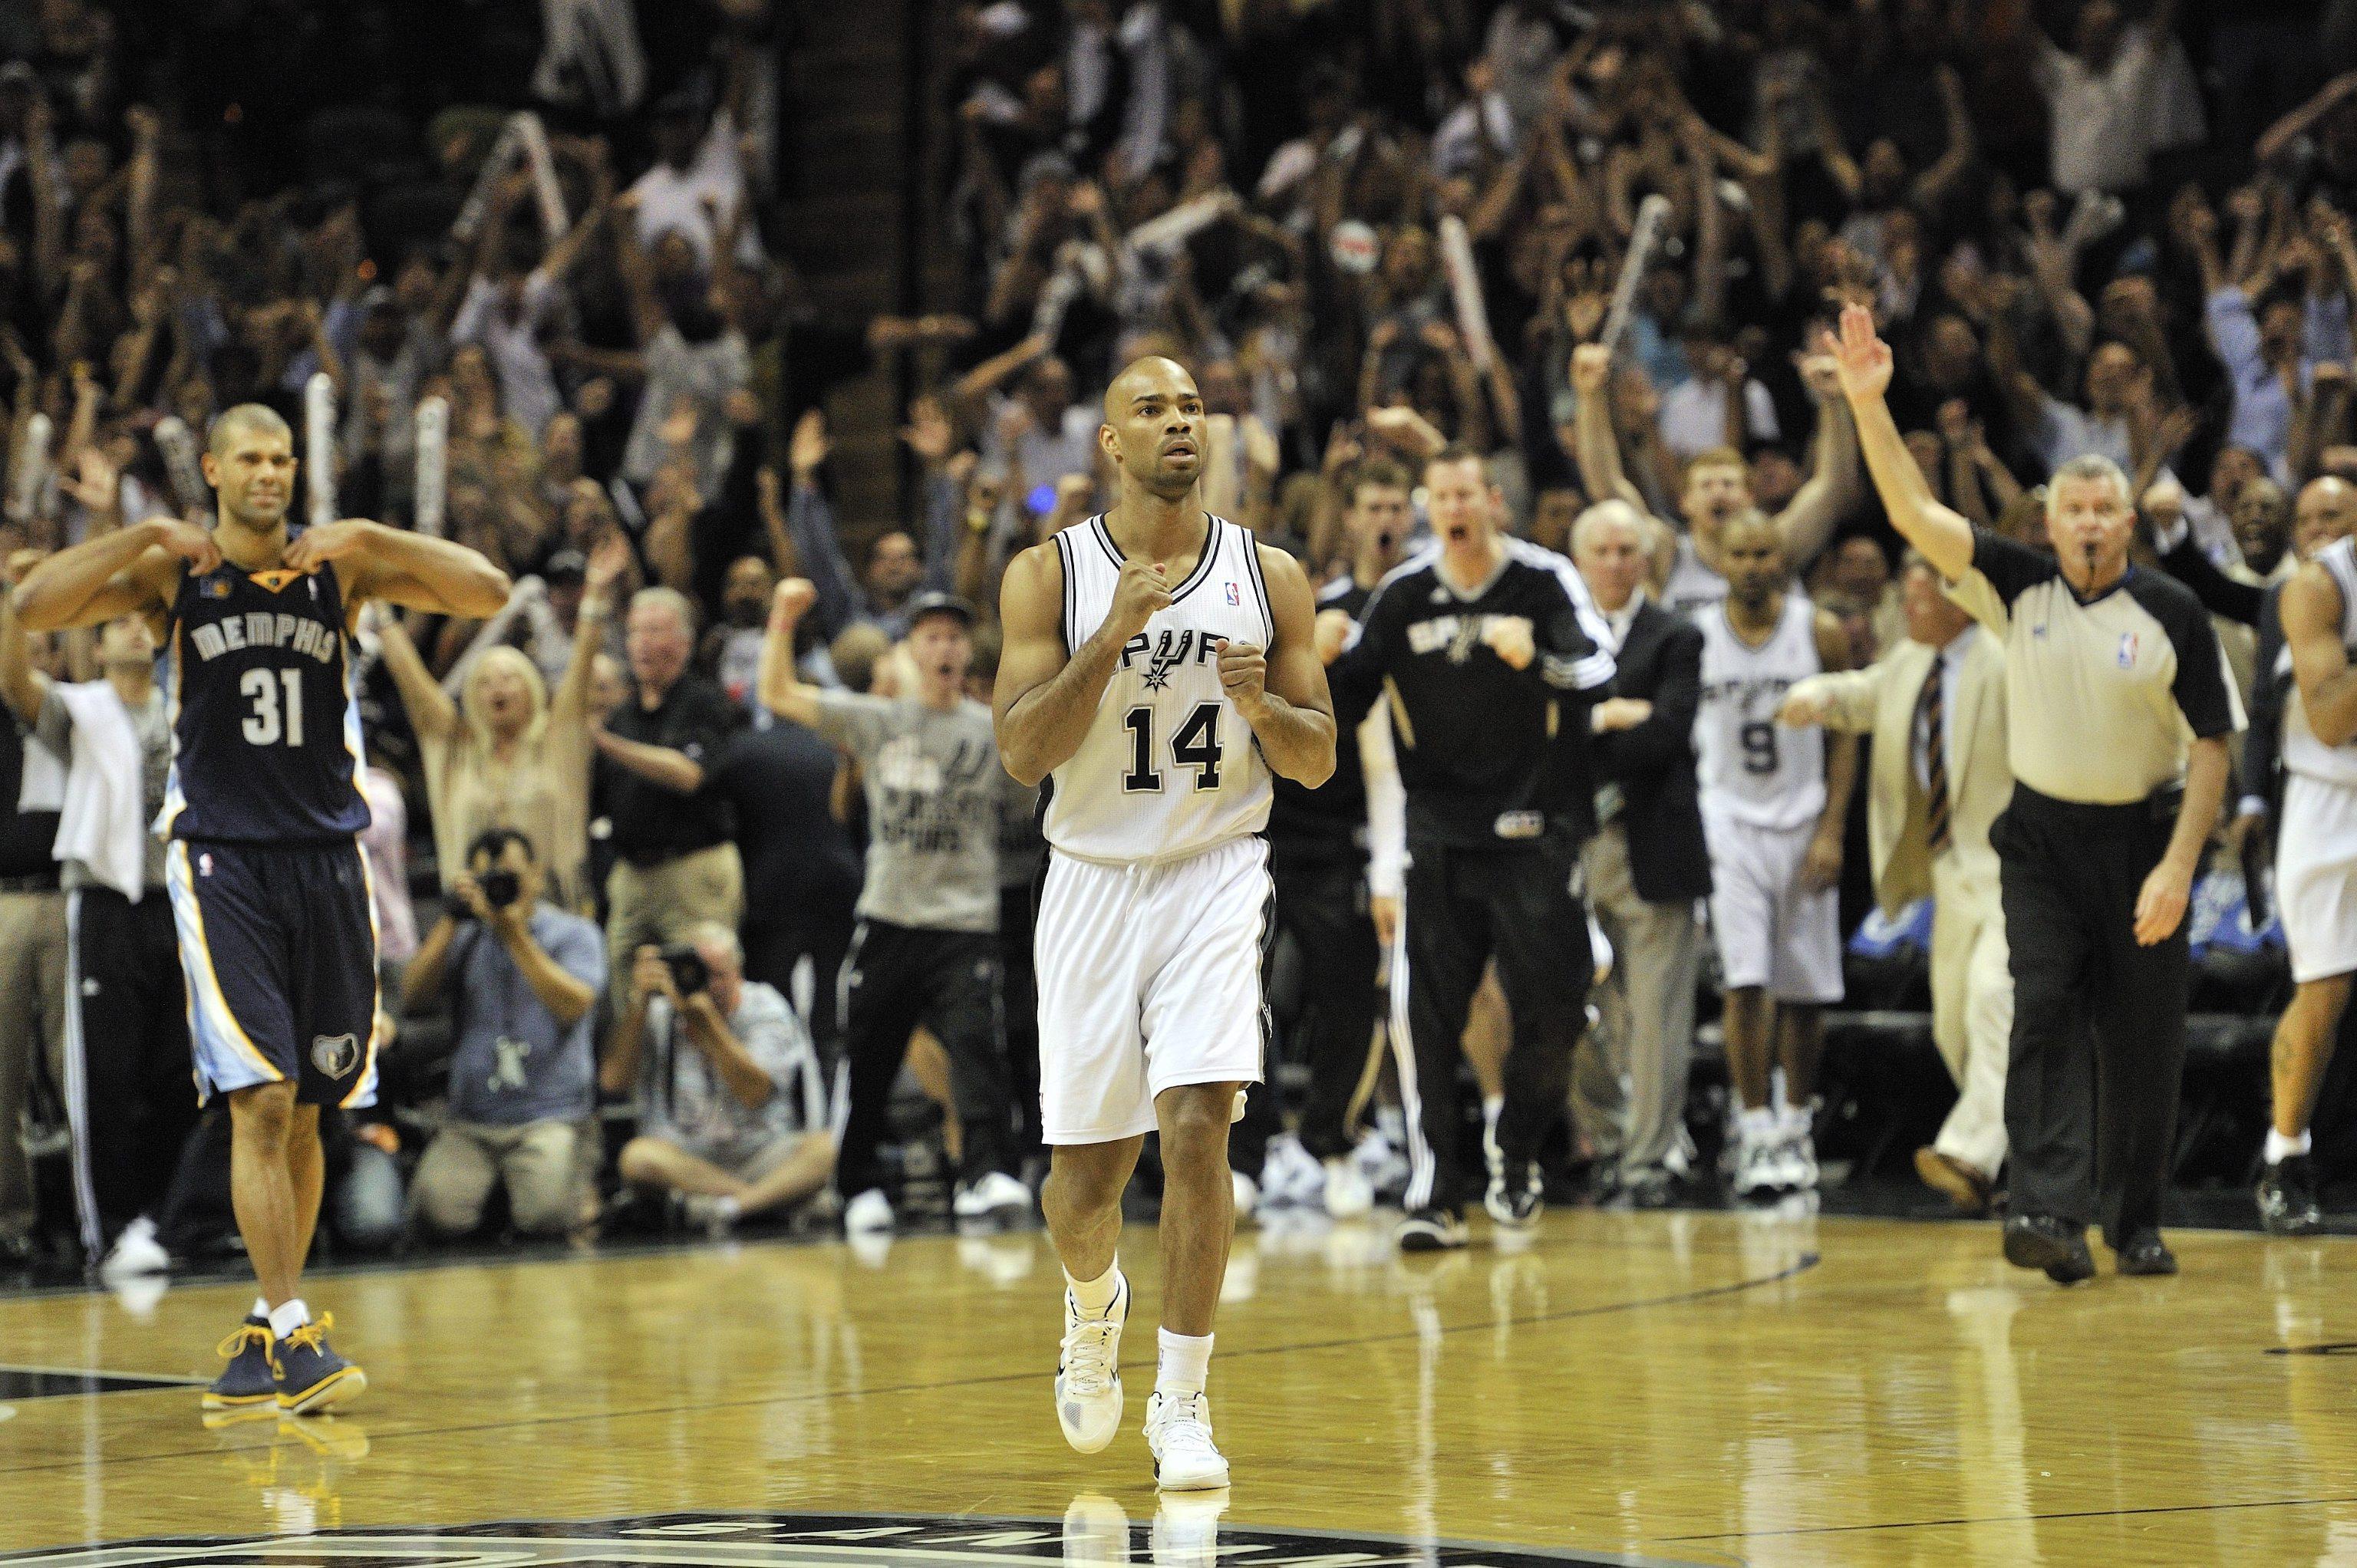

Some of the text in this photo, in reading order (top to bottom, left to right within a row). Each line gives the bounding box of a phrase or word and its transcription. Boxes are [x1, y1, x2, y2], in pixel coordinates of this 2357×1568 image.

[239, 667, 304, 747] 31
[1122, 700, 1225, 795] 14
[1739, 720, 1778, 774] 9
[618, 1522, 1109, 1547] SAN
